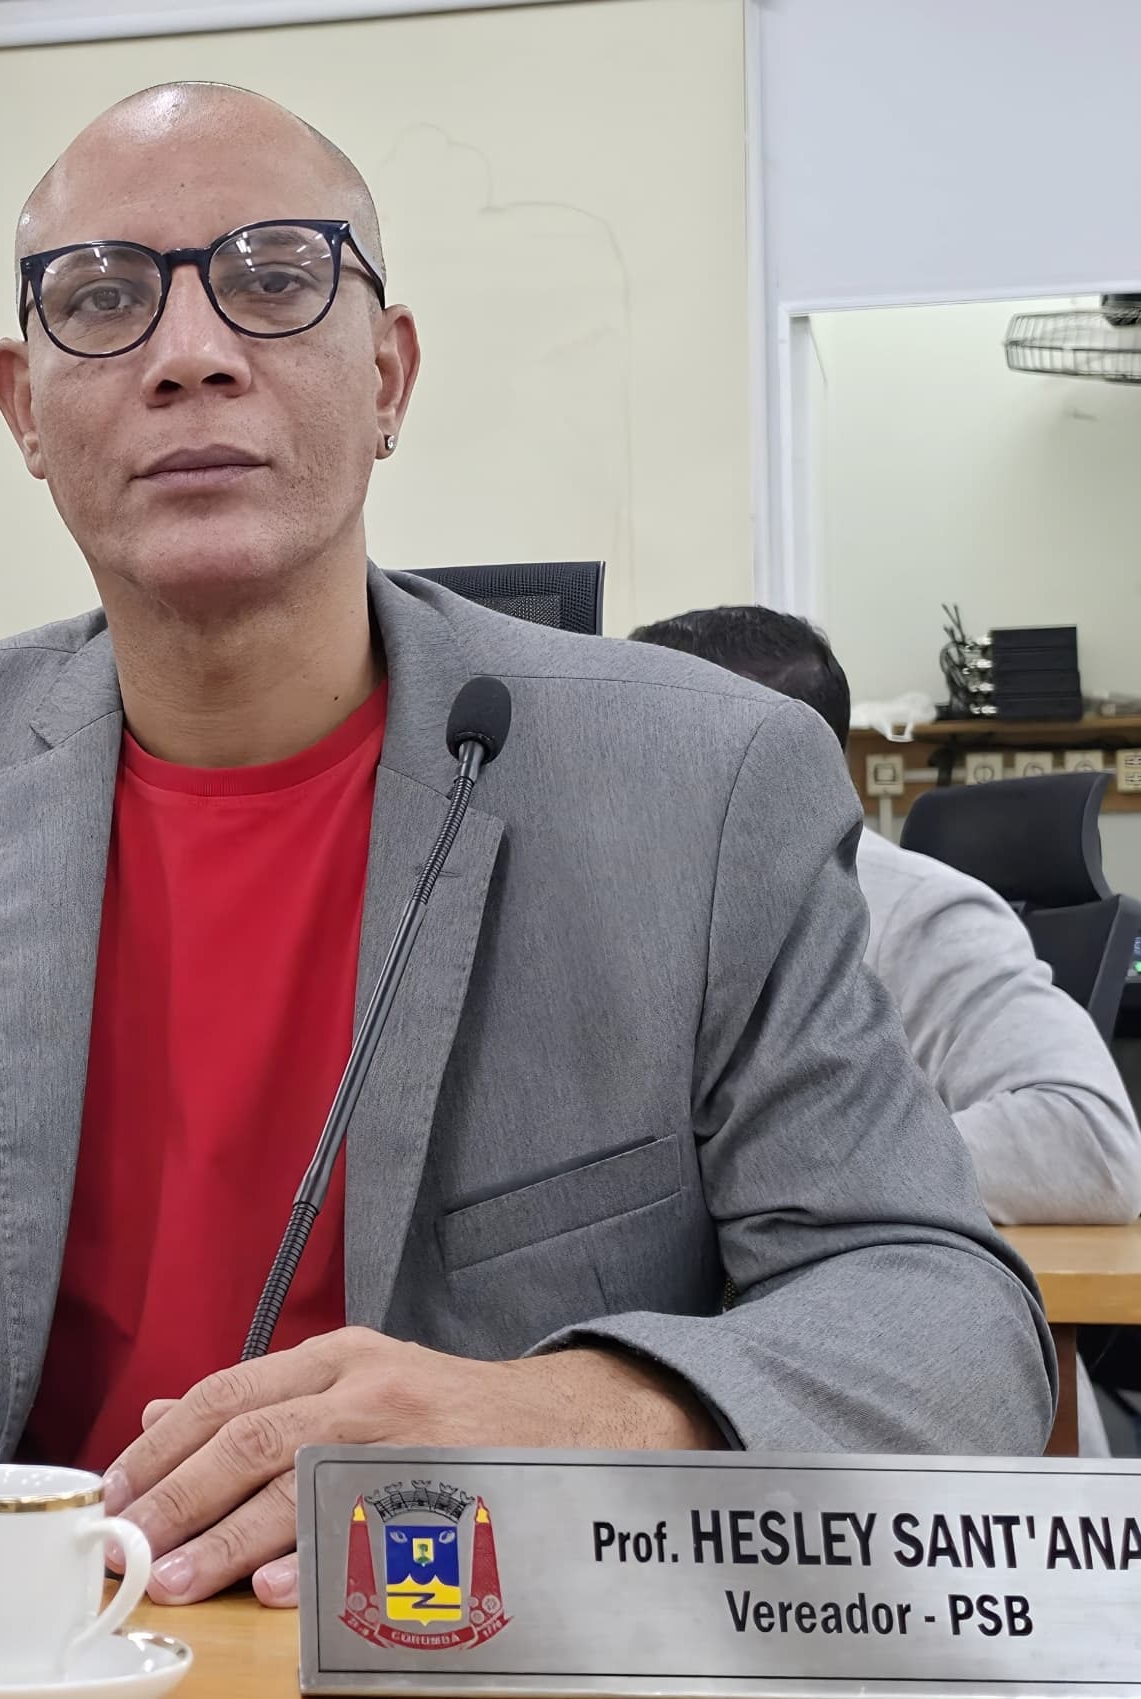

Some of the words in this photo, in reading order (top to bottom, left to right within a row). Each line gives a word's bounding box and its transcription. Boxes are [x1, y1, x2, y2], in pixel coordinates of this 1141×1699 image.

[593, 1521, 679, 1563] Prof.
[691, 1510, 877, 1566] HESLEY
[892, 1512, 1141, 1570] SANT'ANA
[725, 1590, 911, 1635] Vereador
[948, 1594, 1034, 1637] PSB
